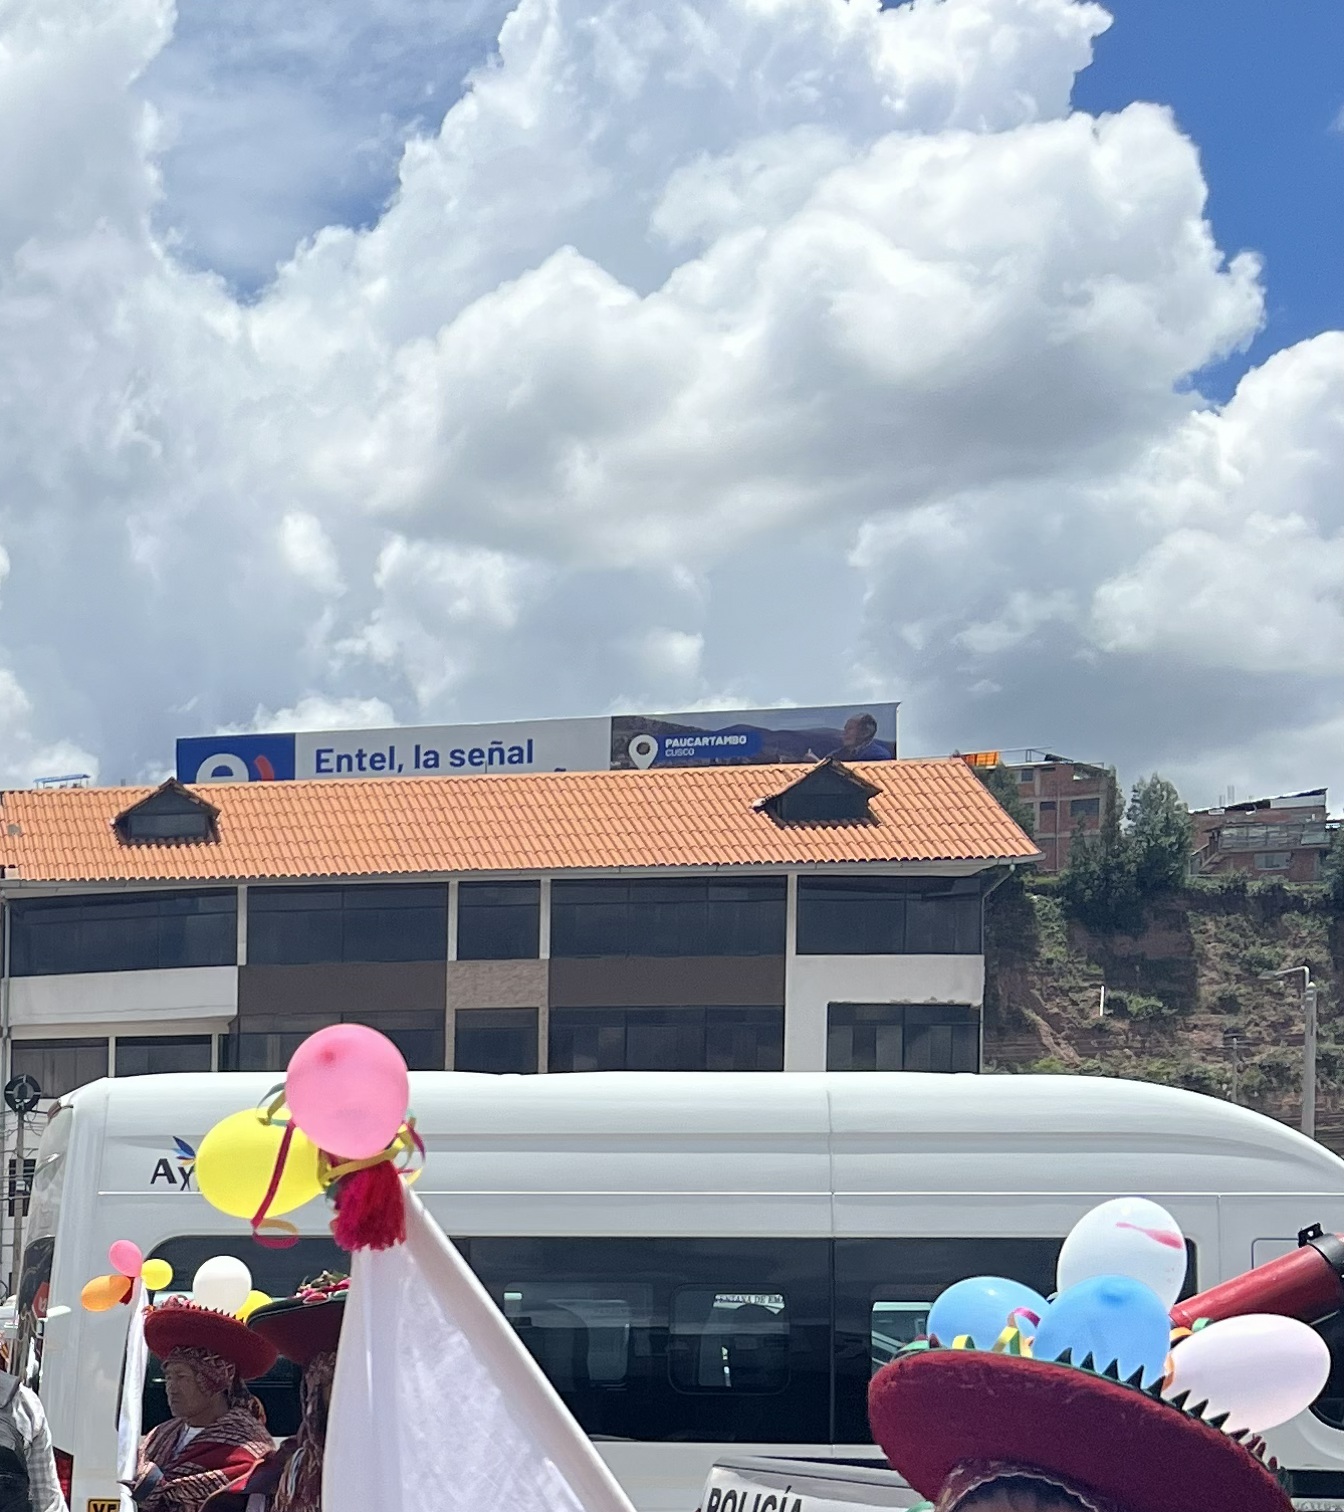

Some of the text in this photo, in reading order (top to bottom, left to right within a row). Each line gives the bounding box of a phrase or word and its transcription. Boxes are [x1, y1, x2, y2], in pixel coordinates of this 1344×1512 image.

[665, 735, 747, 749] PAUCARTAMBO
[315, 738, 534, 774] Entel, la señal
[665, 748, 695, 758] CUSCO
